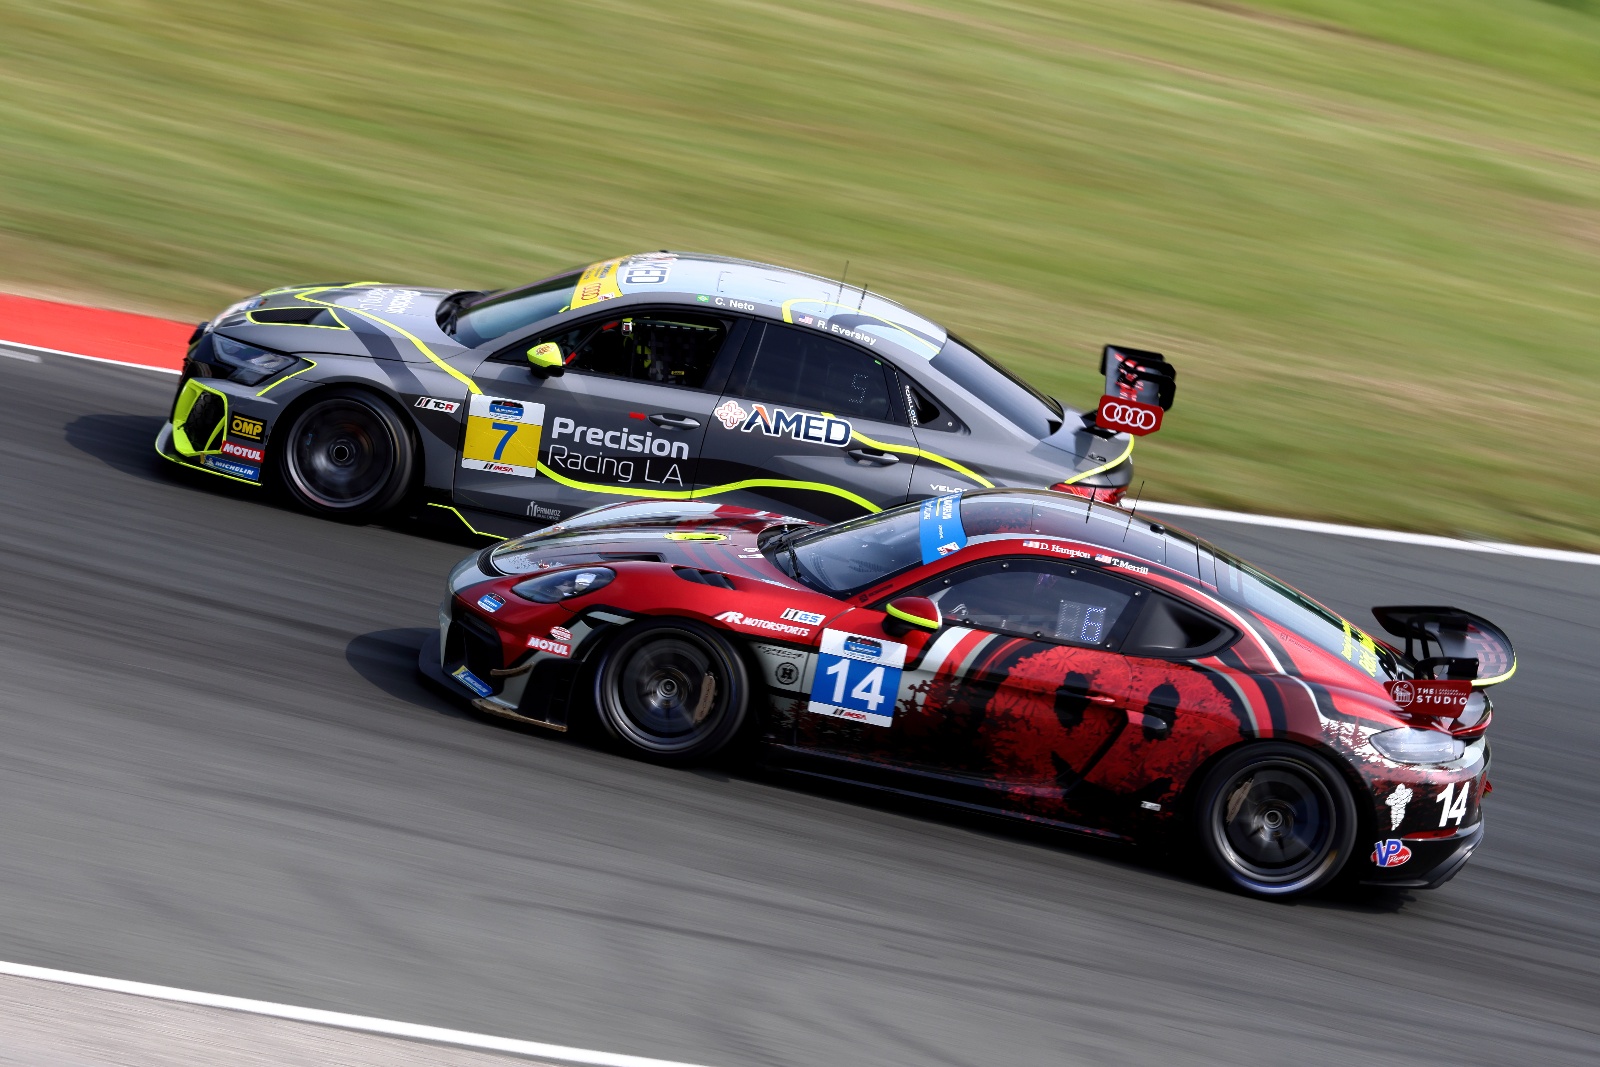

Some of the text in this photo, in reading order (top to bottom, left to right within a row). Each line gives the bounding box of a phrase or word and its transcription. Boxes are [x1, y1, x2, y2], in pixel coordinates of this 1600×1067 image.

[715, 296, 755, 312] C. Neto
[817, 320, 877, 346] R. Eversley
[432, 400, 454, 412] TCR
[231, 419, 263, 437] OMP
[742, 404, 852, 447] AMED
[492, 421, 518, 460] 7
[551, 416, 690, 460] Precision
[223, 443, 262, 460] MOTUL
[214, 459, 255, 476] MICHELIN
[493, 464, 514, 473] IMSA
[547, 445, 684, 487] Racing LA
[1040, 541, 1050, 552] D.
[714, 610, 810, 637] AR MOTORSPORTS
[799, 612, 820, 624] GS
[1081, 607, 1106, 642] 6
[527, 636, 569, 656] MOTUL
[826, 657, 886, 711] 14
[1416, 687, 1435, 696] THE
[1415, 694, 1468, 706] STUDIO
[1435, 782, 1470, 827] 14
[1375, 839, 1403, 867] VP
